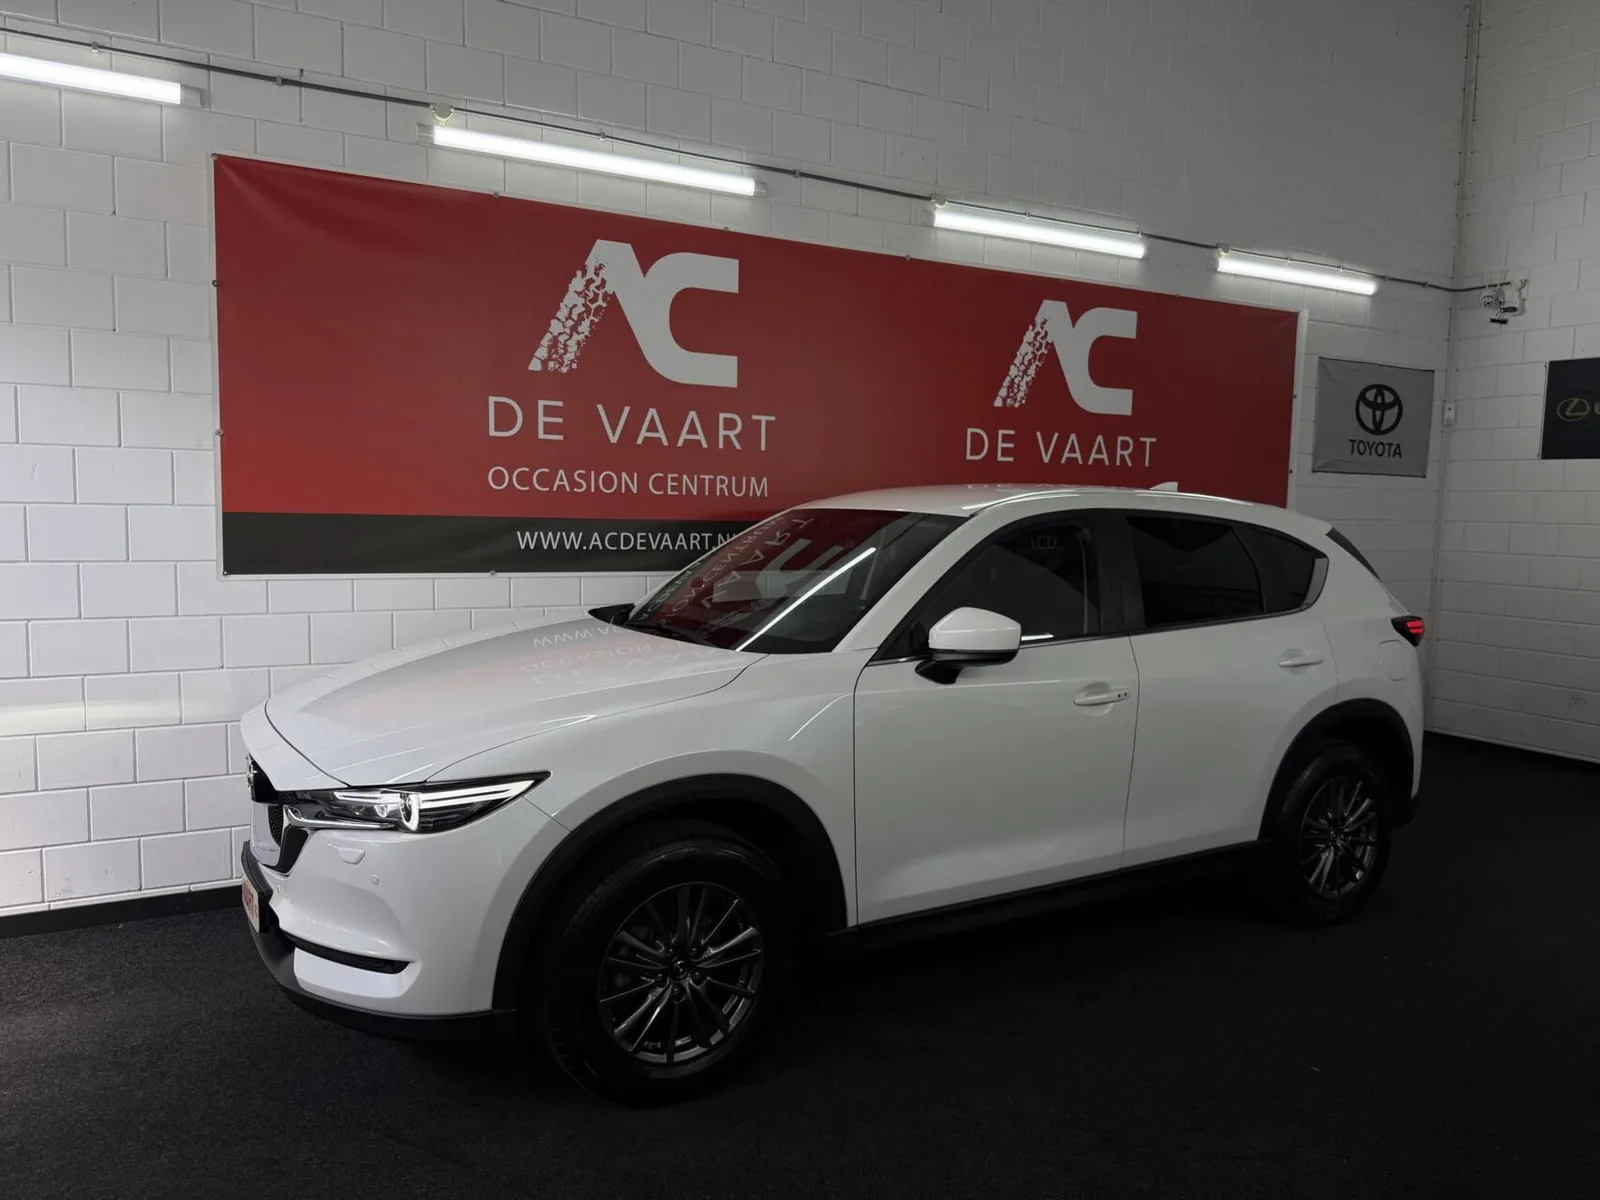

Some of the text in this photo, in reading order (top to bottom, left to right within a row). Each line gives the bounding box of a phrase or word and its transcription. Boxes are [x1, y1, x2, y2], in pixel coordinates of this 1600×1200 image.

[528, 238, 739, 389] AC
[993, 299, 1138, 416] AC
[487, 395, 776, 452] DE VAART
[965, 427, 1157, 468] DE VAART
[1349, 438, 1402, 459] TOYOTA
[487, 466, 769, 498] OCCASION CENTRUM
[516, 530, 736, 551] WWW.ACDEVAART.N
